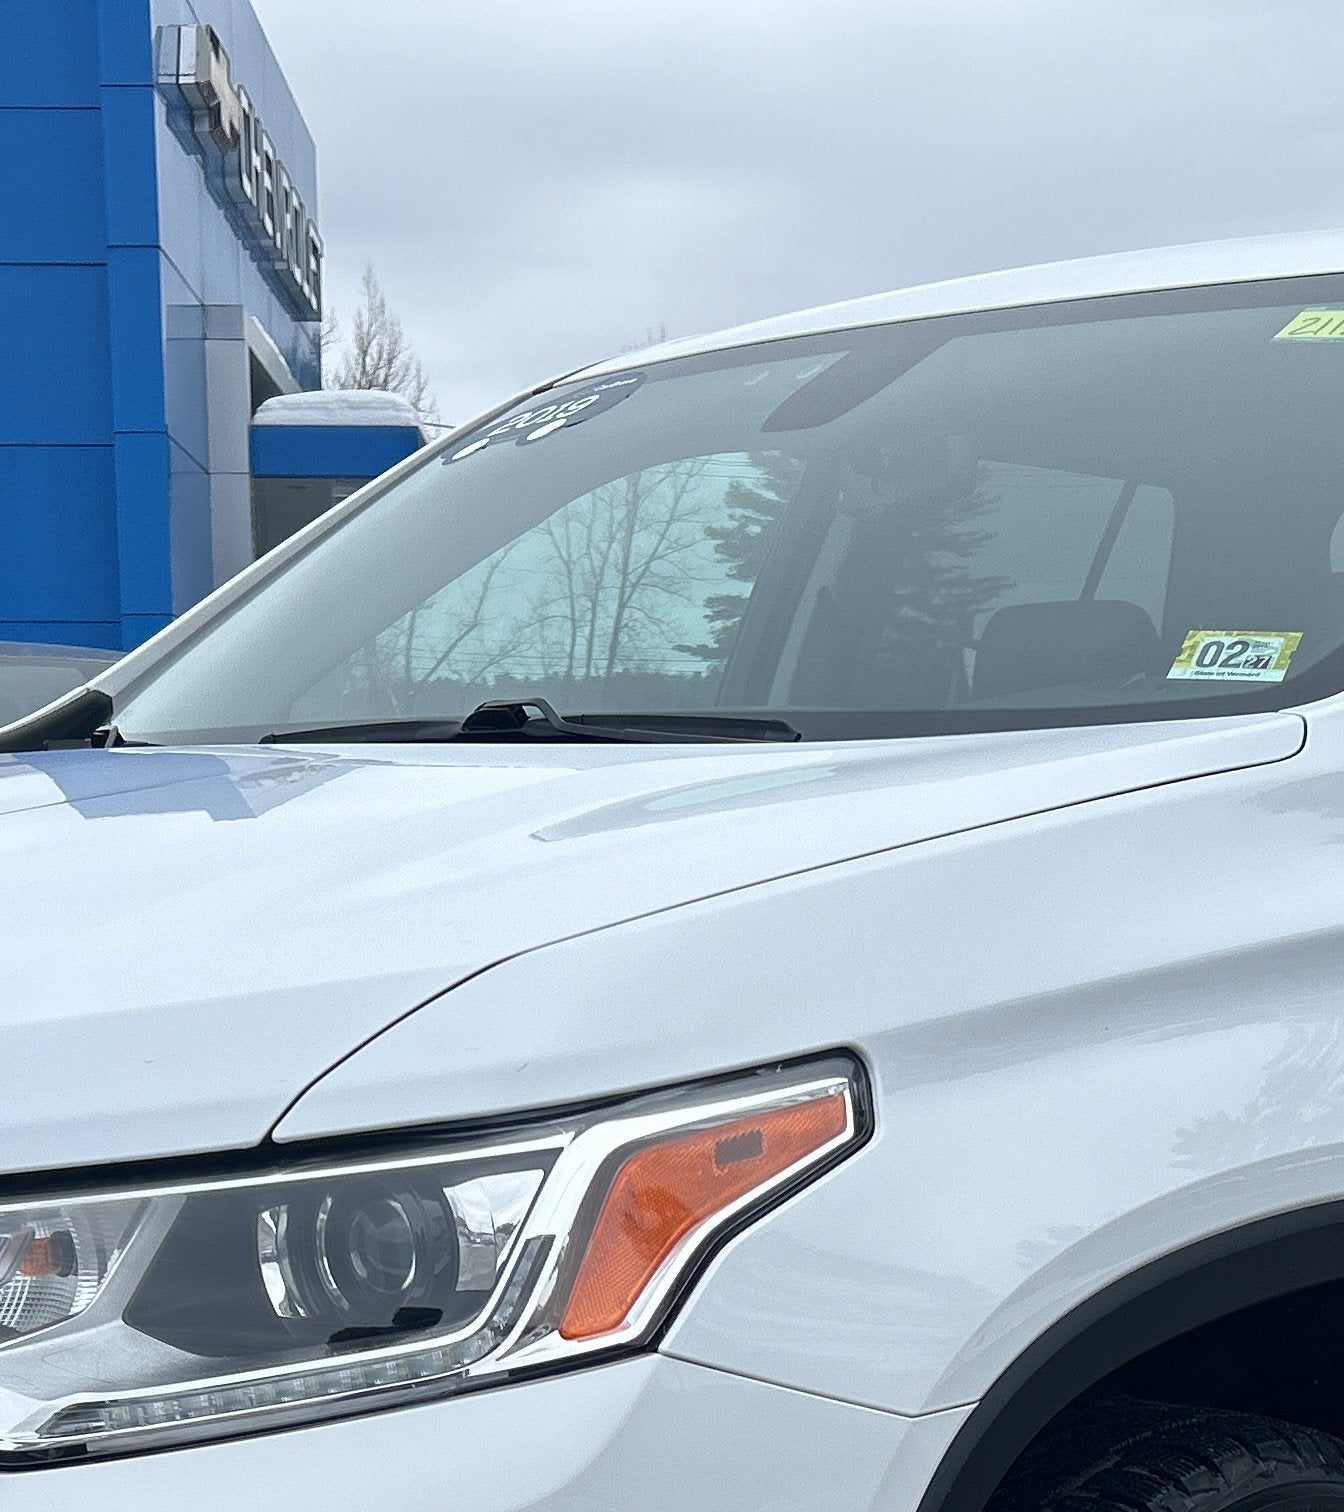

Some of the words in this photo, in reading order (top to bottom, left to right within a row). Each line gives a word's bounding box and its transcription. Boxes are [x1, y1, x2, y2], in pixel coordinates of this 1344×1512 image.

[486, 394, 600, 437] 2019
[1195, 640, 1251, 669] 02
[1244, 654, 1272, 669] 27
